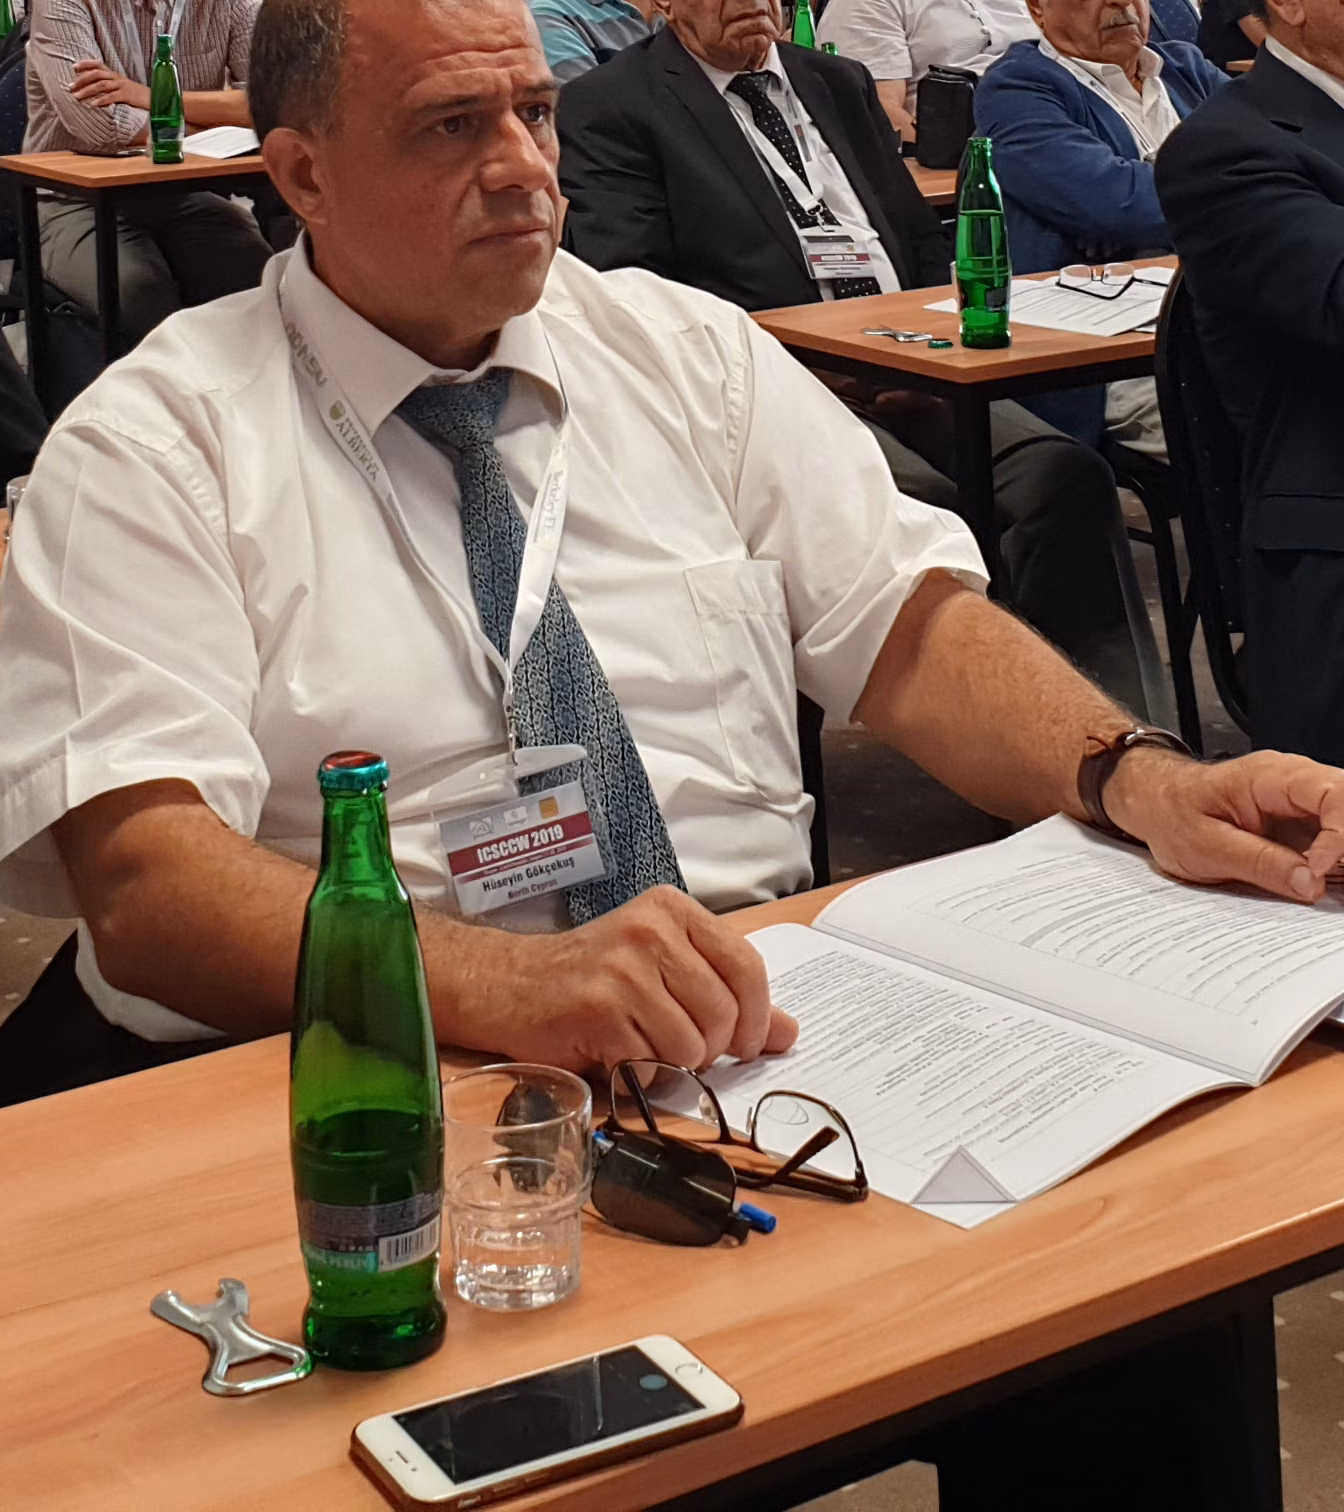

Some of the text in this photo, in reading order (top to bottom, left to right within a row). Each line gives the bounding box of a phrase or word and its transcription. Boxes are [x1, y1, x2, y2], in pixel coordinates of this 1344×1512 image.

[336, 422, 379, 480] ALBERTA
[477, 834, 530, 864] ICSCCW
[531, 824, 564, 848] 2019
[482, 872, 523, 893] Hüseyin
[525, 856, 576, 876] Gökçekuş
